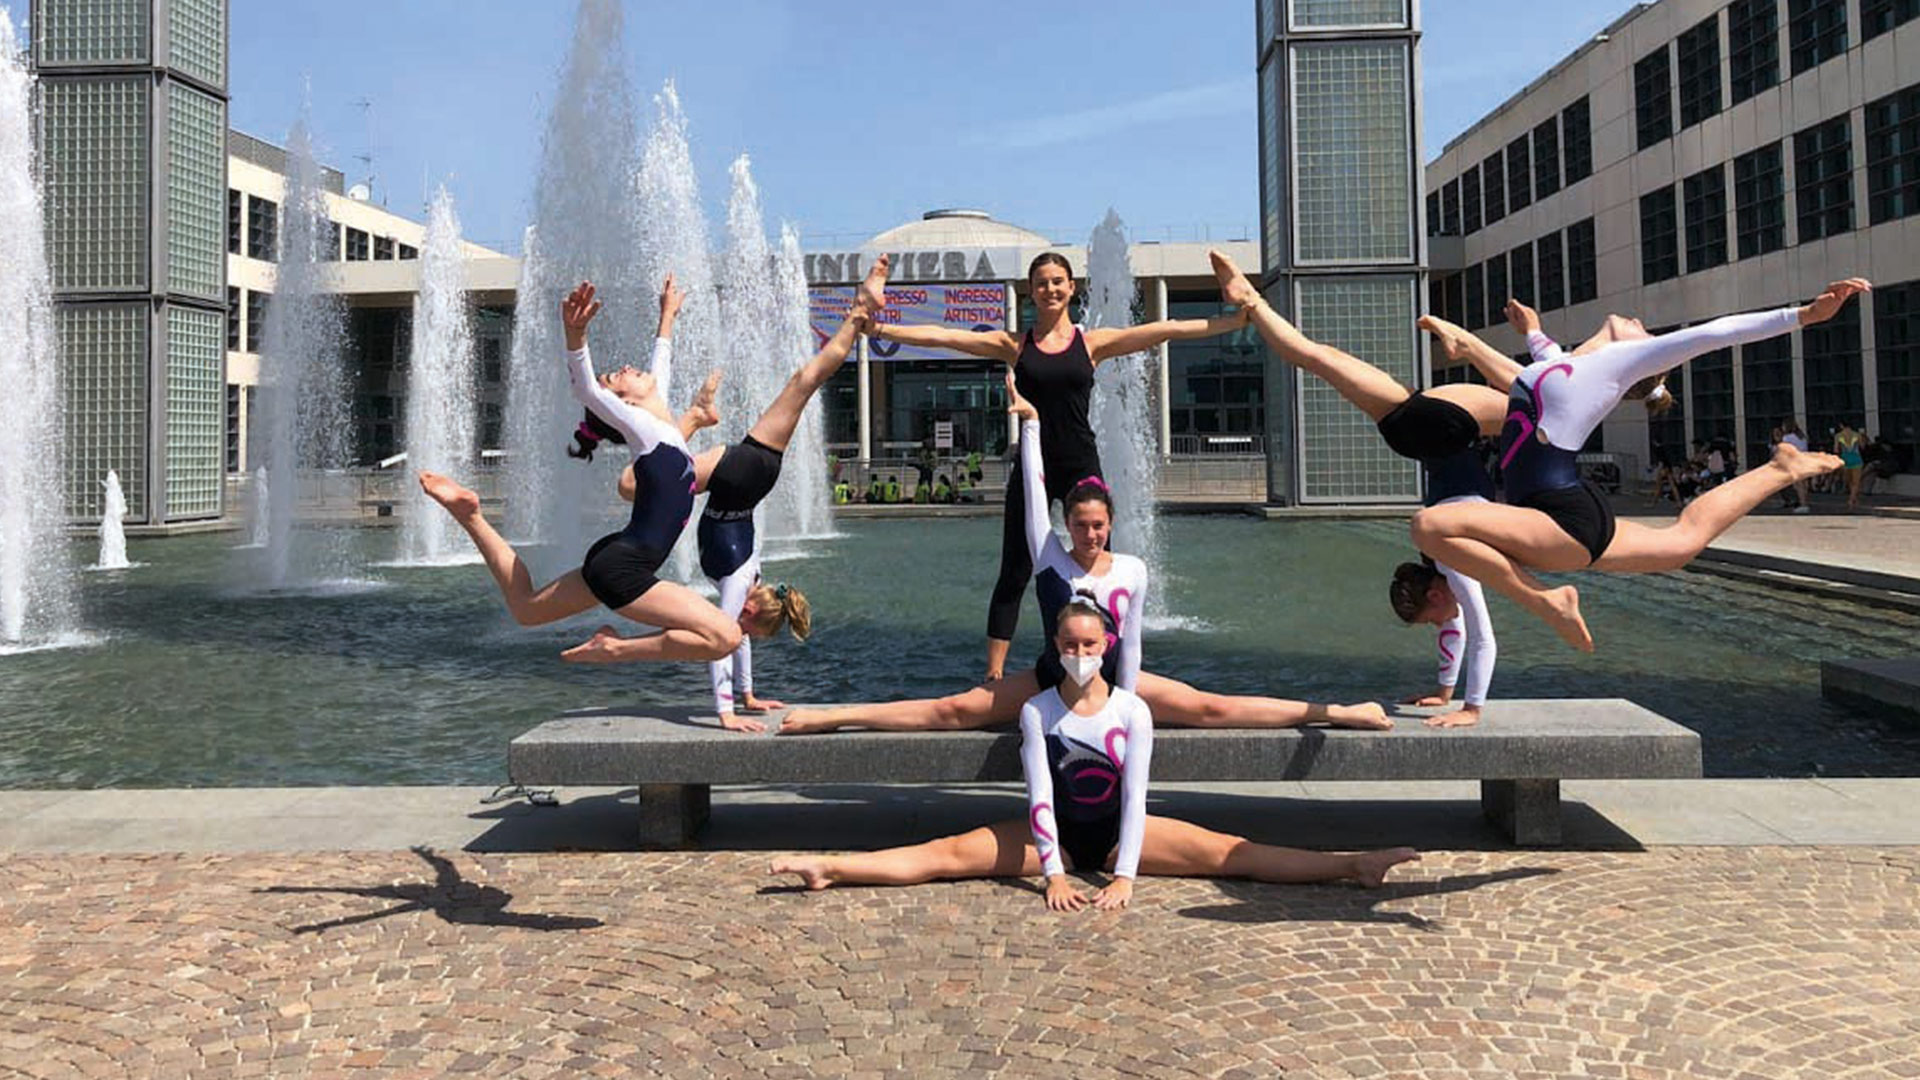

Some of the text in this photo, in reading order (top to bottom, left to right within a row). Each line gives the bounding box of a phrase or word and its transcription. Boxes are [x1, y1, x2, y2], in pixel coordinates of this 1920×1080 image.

[804, 253, 860, 282] INI
[944, 288, 1004, 304] INGRESSO
[944, 307, 1004, 323] ARTISTICA
